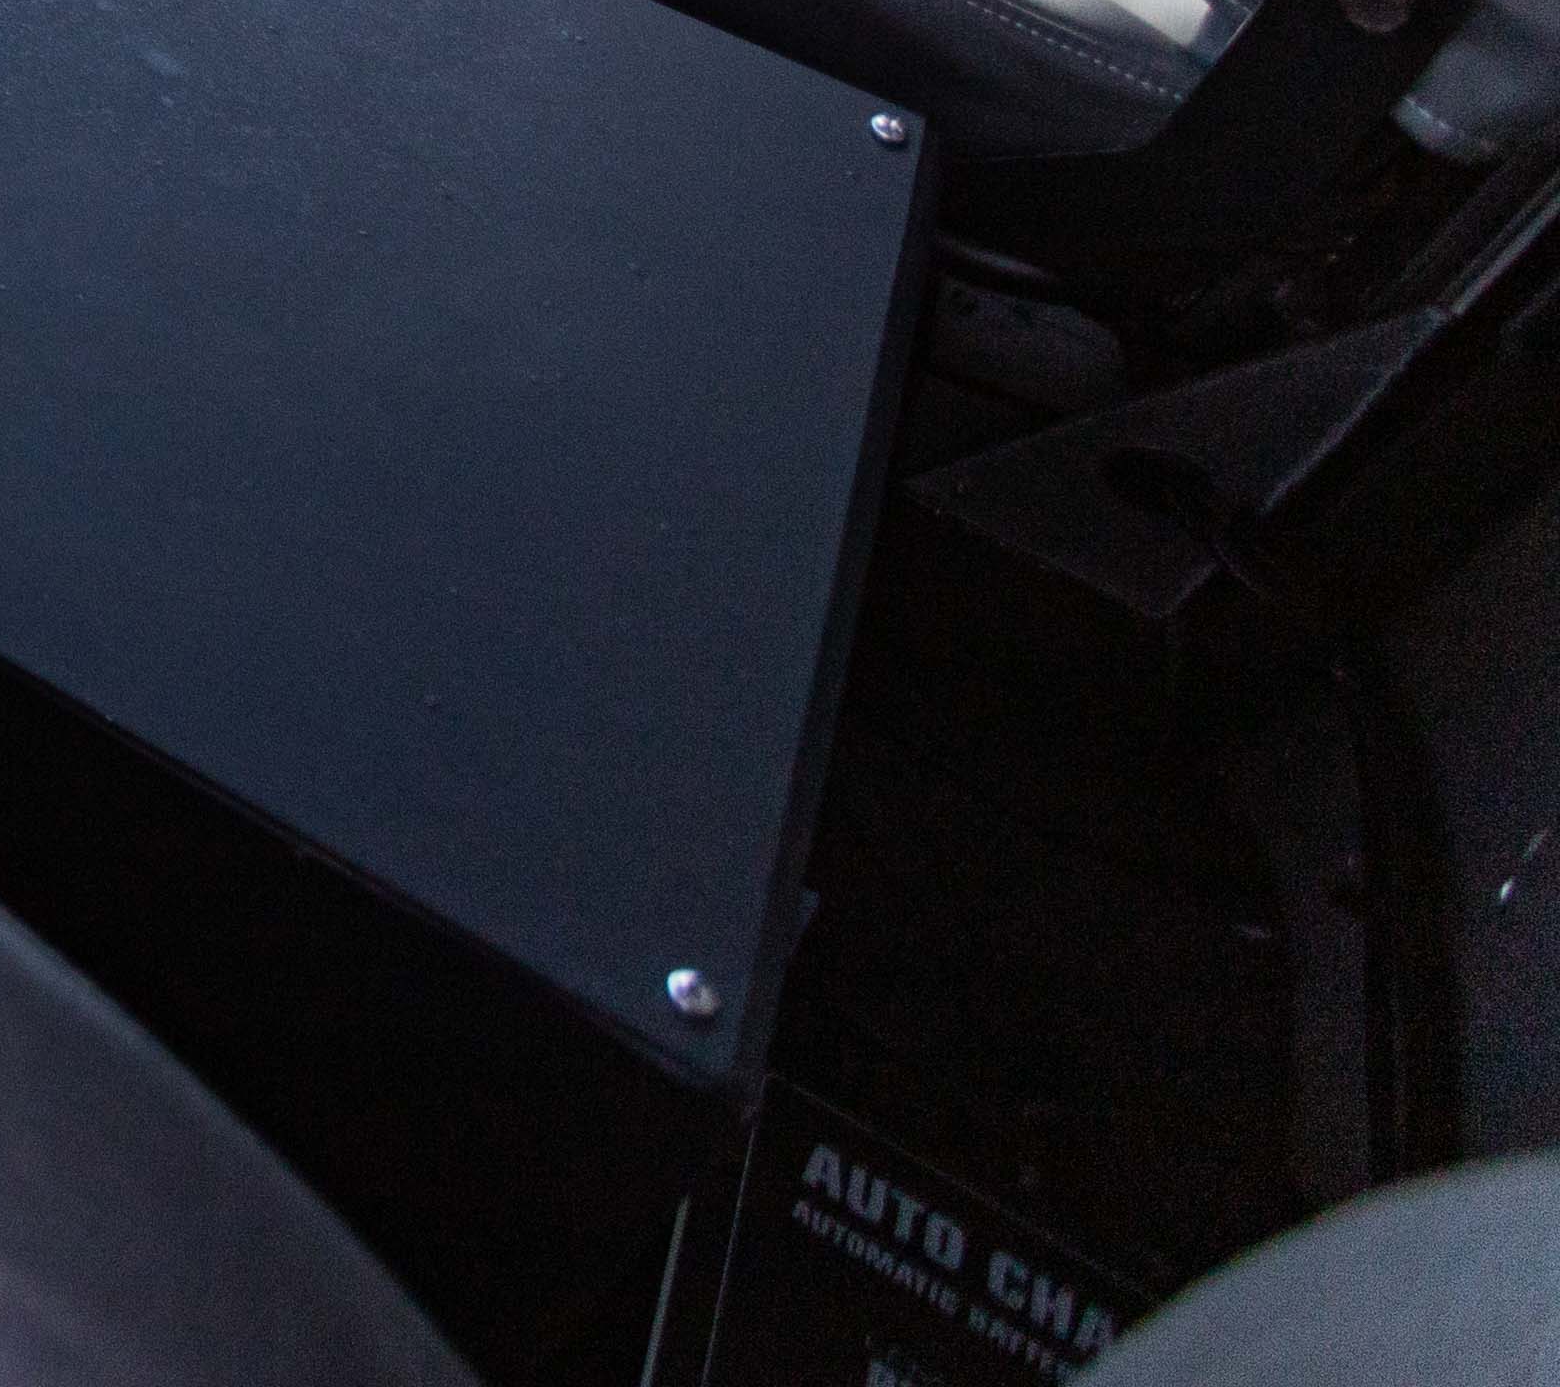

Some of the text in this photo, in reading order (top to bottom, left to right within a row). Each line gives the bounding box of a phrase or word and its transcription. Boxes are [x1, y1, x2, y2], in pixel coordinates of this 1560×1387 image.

[792, 1199, 960, 1315] AUTOMATIC
[802, 1141, 968, 1273] AUTO
[986, 1249, 1118, 1357] CHA
